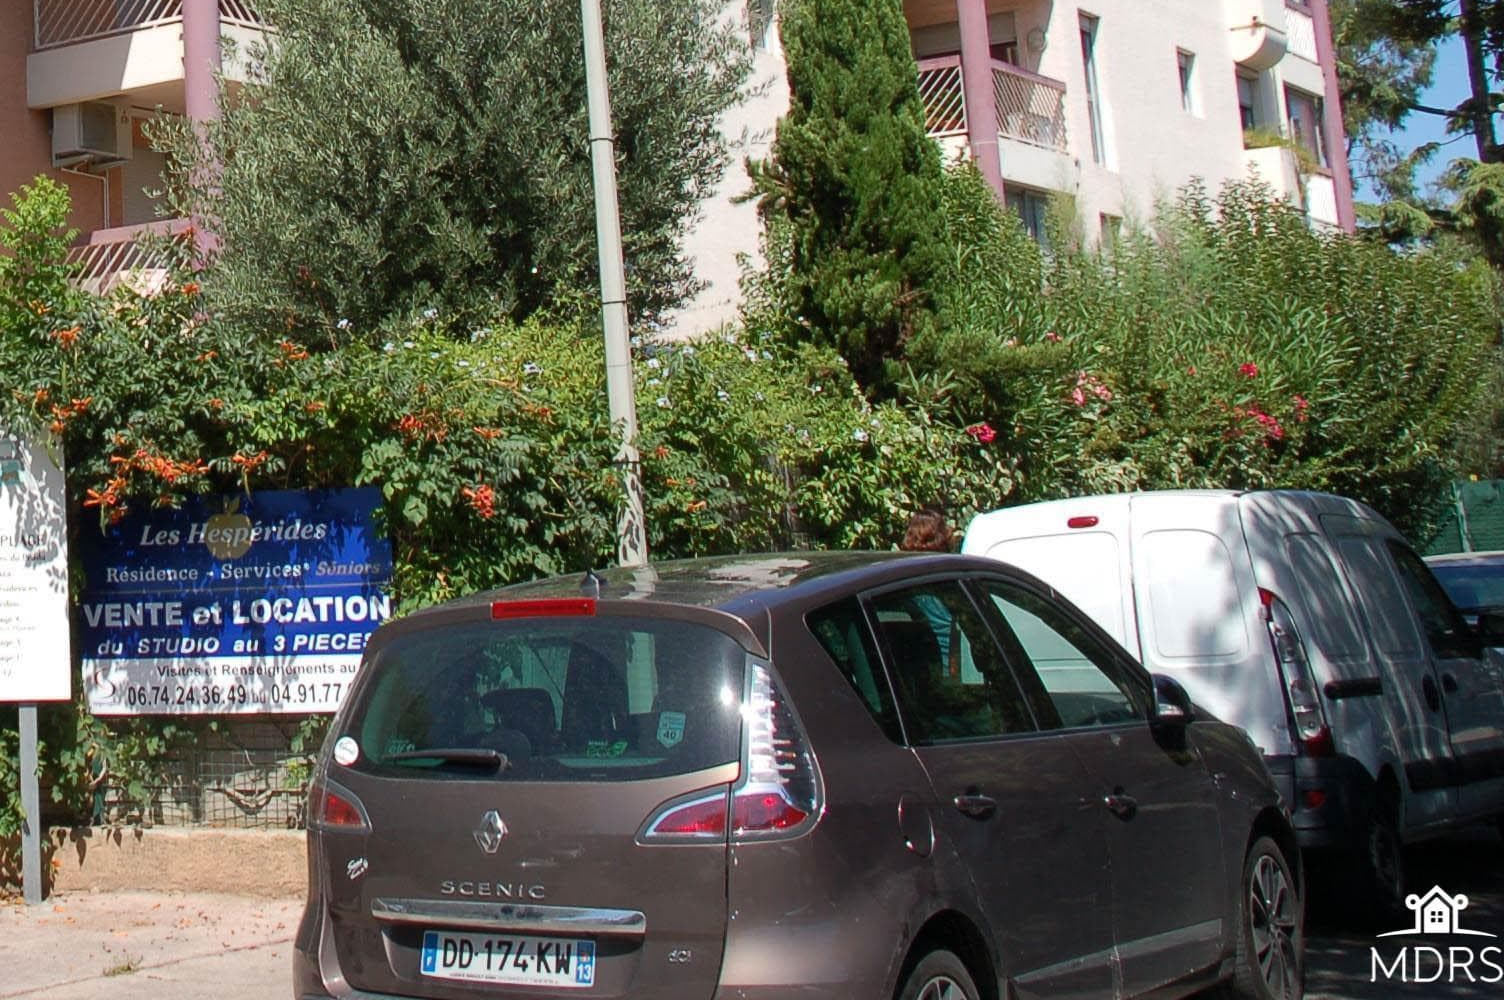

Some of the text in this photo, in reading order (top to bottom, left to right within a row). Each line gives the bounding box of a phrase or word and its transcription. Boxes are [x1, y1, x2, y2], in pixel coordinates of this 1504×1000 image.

[140, 519, 328, 547] Les Hespérides
[106, 566, 199, 583] Résidence
[83, 595, 391, 627] VENTE et LOCATION
[97, 640, 123, 655] du
[138, 637, 220, 654] STUDIO
[233, 638, 259, 652] au
[273, 634, 286, 651] 3
[157, 663, 356, 678] Visites et Renseignements au
[128, 685, 246, 706] 06.74.24.36.49
[271, 683, 353, 704] 04.91.77
[440, 881, 545, 899] SCENIC
[577, 963, 592, 980] 13
